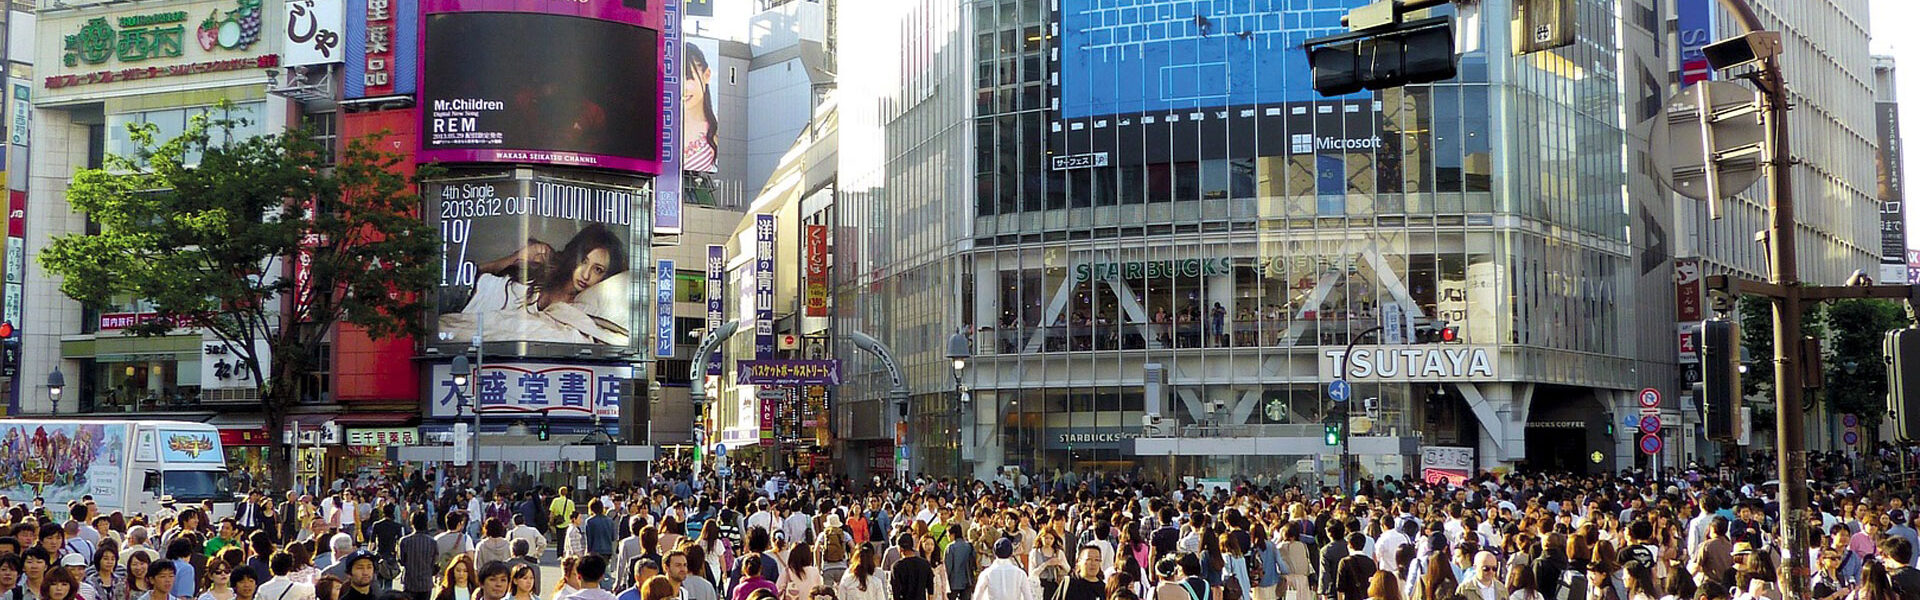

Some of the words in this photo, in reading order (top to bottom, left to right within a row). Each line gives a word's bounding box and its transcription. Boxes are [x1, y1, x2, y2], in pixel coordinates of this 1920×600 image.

[116, 24, 186, 62] 西村
[434, 99, 504, 110] Mr.Children
[1316, 135, 1381, 149] Microsoft
[497, 152, 528, 160] WAKASA
[530, 153, 562, 162] SEIKATSU
[564, 155, 597, 163] CHANNEL
[442, 185, 460, 199] 4th
[463, 184, 494, 200] Single
[441, 198, 501, 219] 2013.6.12
[505, 196, 537, 216] OUT
[757, 219, 773, 311] 洋服の青山
[1076, 256, 1233, 283] STARBUCKS
[660, 266, 671, 350] 大盛堂商事ビル
[102, 317, 134, 327] 国内旅行
[751, 364, 829, 378] バスケットボールストリート
[1326, 349, 1492, 378] TSUTAYA
[440, 371, 620, 408] 大盛堂書店
[1060, 433, 1120, 443] STARBUCKS
